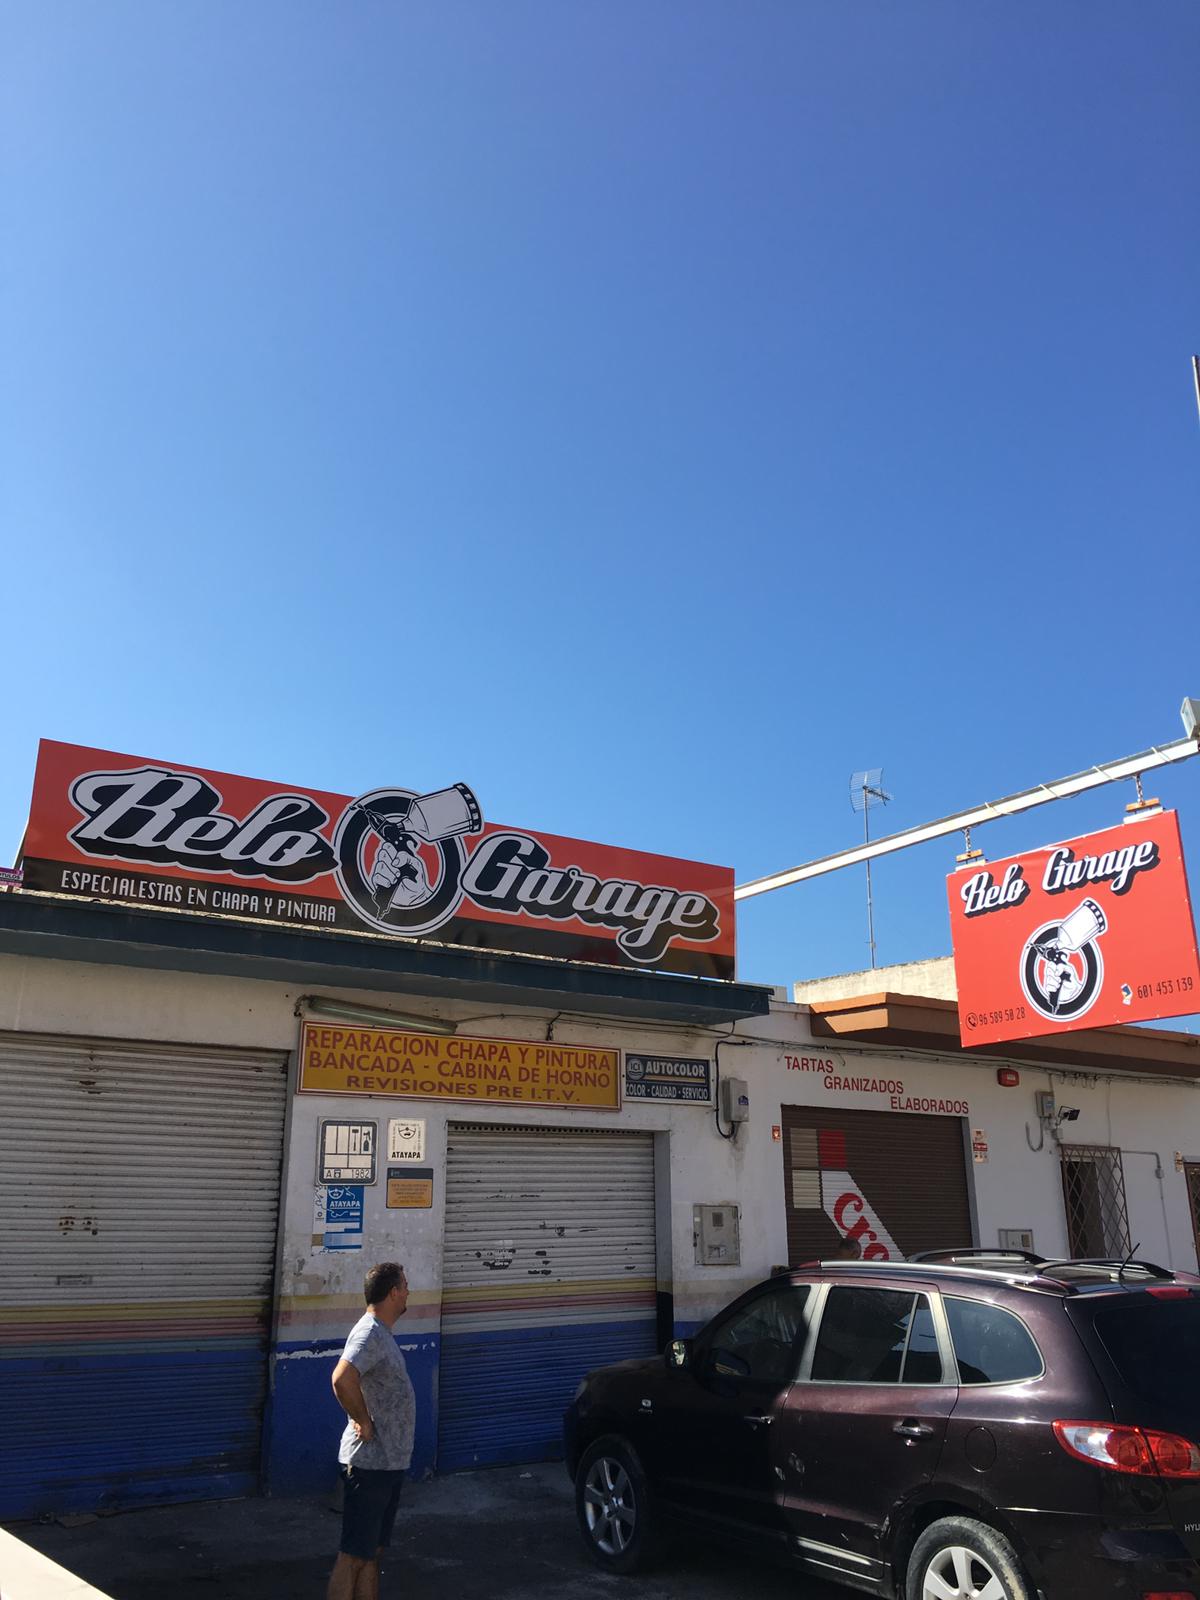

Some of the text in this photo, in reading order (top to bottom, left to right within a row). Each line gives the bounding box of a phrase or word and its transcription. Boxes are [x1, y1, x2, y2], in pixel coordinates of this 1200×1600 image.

[68, 765, 333, 878] Belo
[960, 842, 1158, 916] Belo Garage
[61, 869, 336, 922] ESPECIALESTAS EN CHAPA Y PINTURA
[461, 832, 715, 957] Garage
[1137, 976, 1193, 999] 601 453 139
[978, 1013, 988, 1025] 96
[1016, 1006, 1026, 1020] 28
[306, 1029, 611, 1072] REPARACION CHAPA Y PINTURA
[309, 1051, 415, 1075] BANCADA
[437, 1060, 511, 1082] CABINA
[518, 1067, 540, 1083] DE
[547, 1069, 610, 1089] HORNO
[645, 1061, 706, 1077] AUTOCOLOR
[784, 1056, 834, 1073] TARTAS
[347, 1075, 477, 1096] REVISIONES
[486, 1084, 522, 1099] PRE
[626, 1083, 646, 1097] COLOR
[651, 1086, 677, 1099] CALIDAD
[682, 1087, 709, 1100] SERVICIO
[824, 1076, 904, 1094] GRANIZADOS
[890, 1096, 969, 1114] ELABORADOS
[392, 1151, 421, 1159] ATAYAPA
[329, 1200, 361, 1208] ATAYAPA
